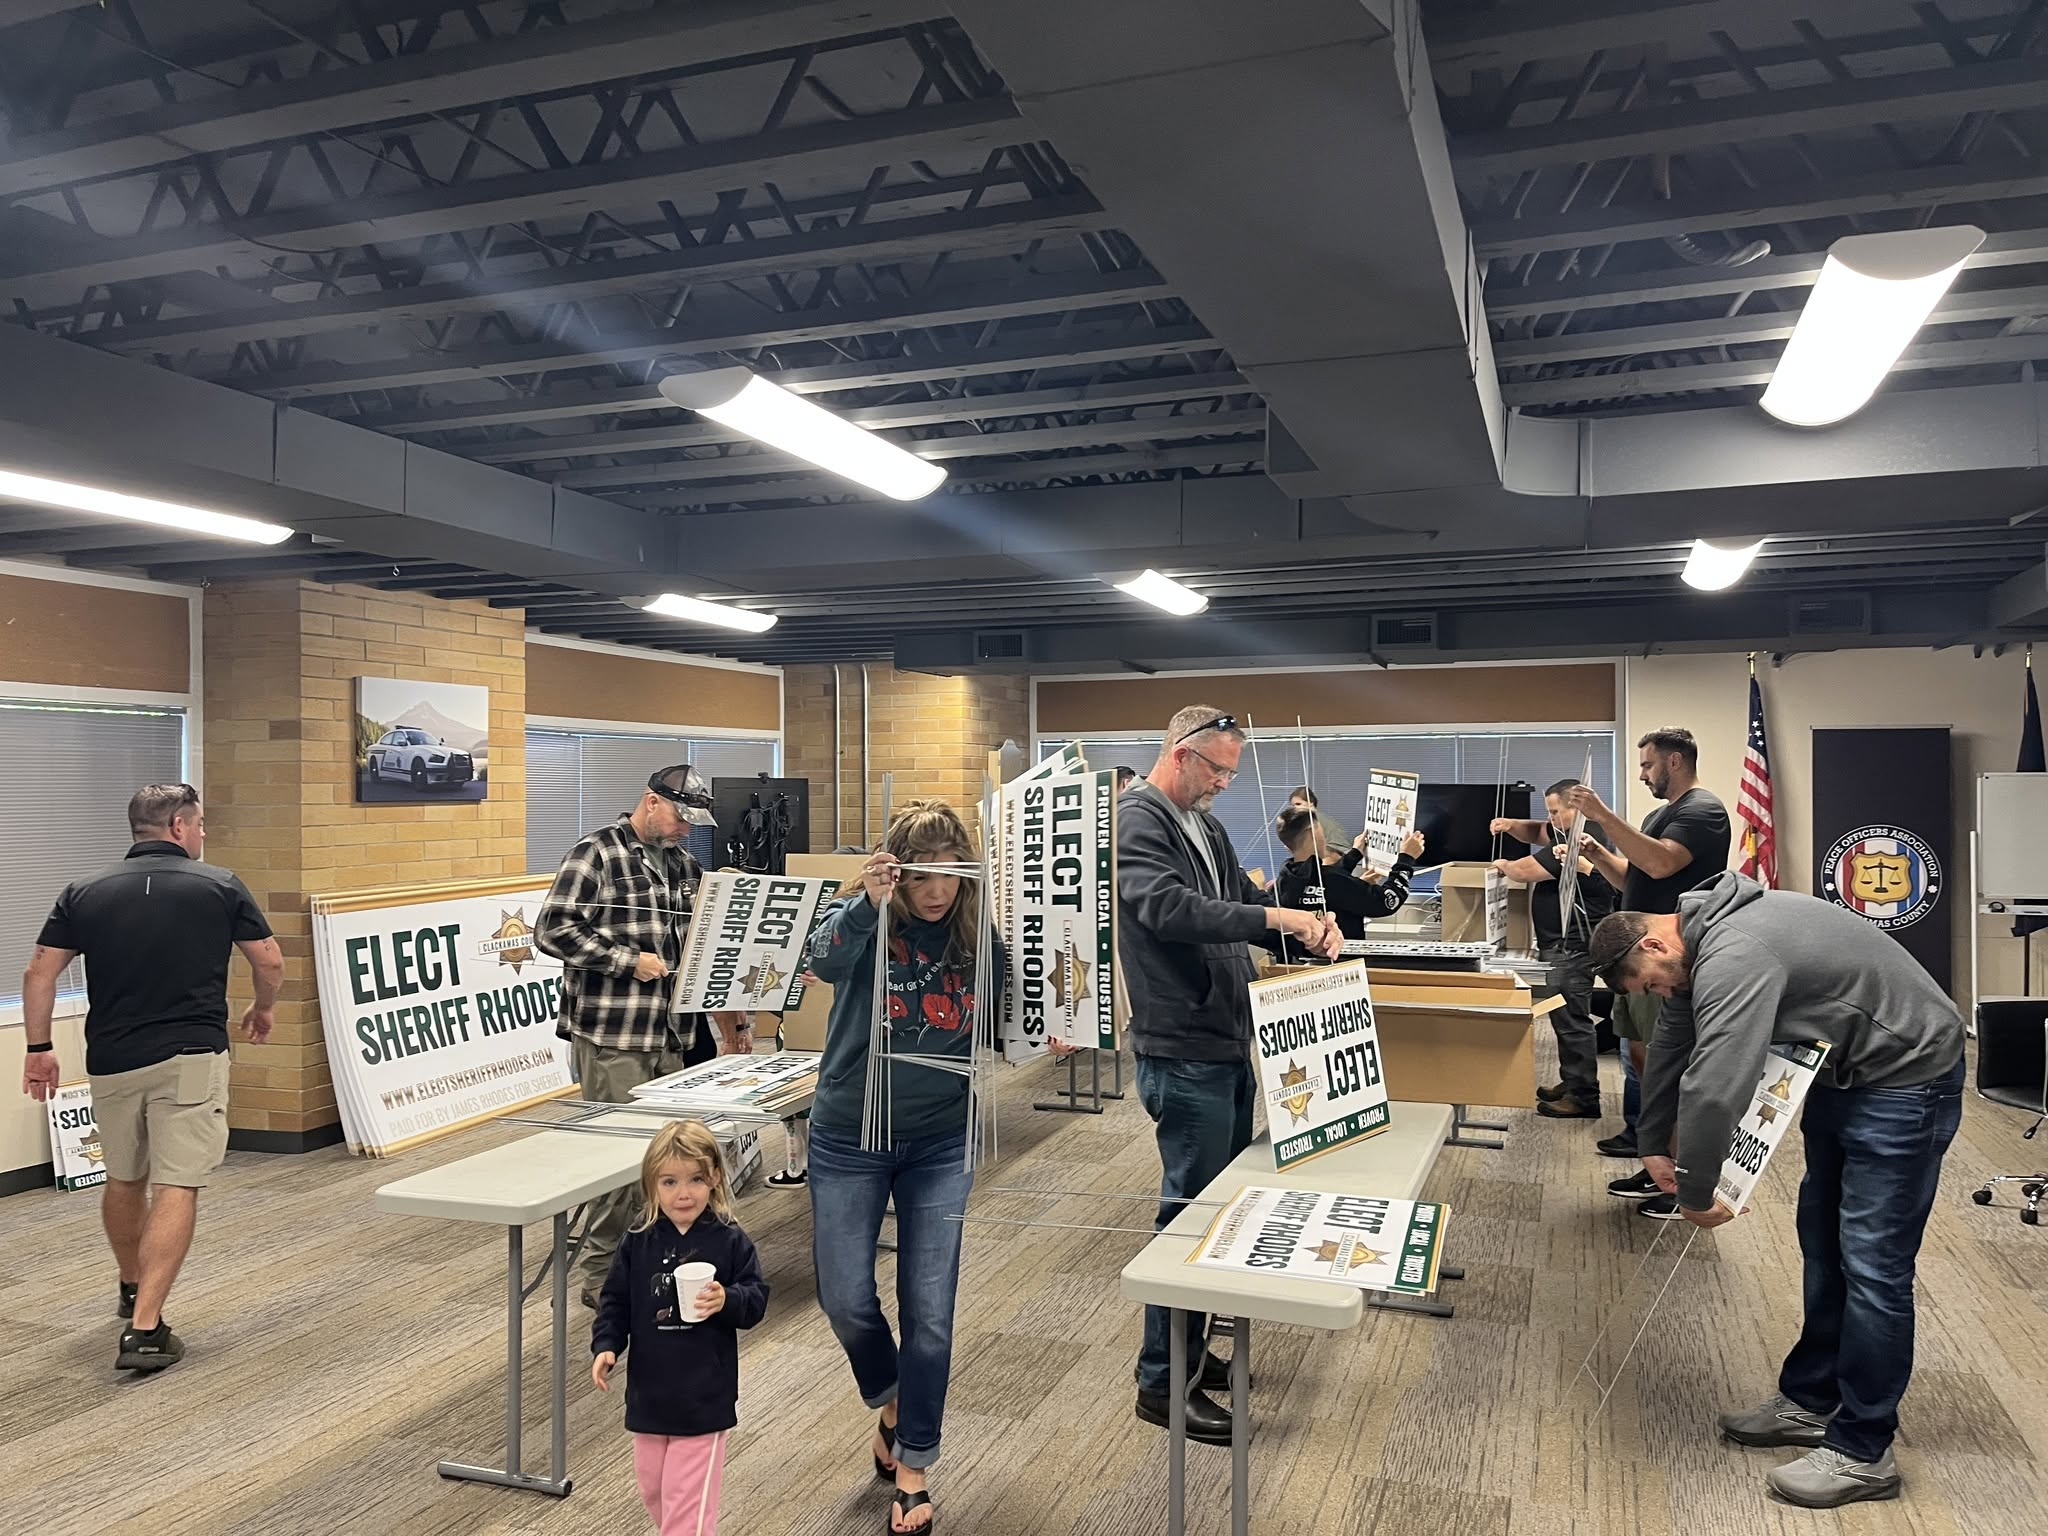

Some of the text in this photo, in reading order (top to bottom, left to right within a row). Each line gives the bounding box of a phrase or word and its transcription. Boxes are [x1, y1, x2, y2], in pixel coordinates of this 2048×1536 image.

[1367, 795, 1391, 826] ELECT
[1051, 784, 1083, 913] ELECT
[1824, 828, 1939, 878] PEACE OFFICERS ASSOCIATION
[753, 880, 807, 950] ELECT
[1003, 799, 1015, 1024] WWW.ELECTSHERIFFRHODES.COM
[1022, 785, 1044, 1038] SHERIFF RHODES
[1097, 785, 1113, 1035] PROVEN LOCAL TRUSTED
[1892, 900, 1931, 927] COUNTY
[345, 923, 461, 1006] ELECT
[482, 936, 534, 952] CLACKAMAS COU
[701, 877, 761, 1009] SHERIFF RHODES
[355, 995, 470, 1066] SHERIFF
[1065, 990, 1073, 1029] COUNTY
[1258, 997, 1372, 1059] SHERIFF RHODES
[380, 1046, 555, 1111] WWW.ELECTSHERIFFRHODES.COM
[1273, 1077, 1320, 1101] CLACKAMAS COUNTY
[1324, 1040, 1381, 1101] ELECT
[59, 1106, 96, 1130] DES
[390, 1071, 563, 1138] PAID FOR BY JAMES RHODES FOR SHERIFF
[1280, 1106, 1385, 1161] PROVEN LOCAL TRUSTED
[75, 1172, 107, 1188] RUSTED
[1729, 1126, 1770, 1176] RHODES
[1244, 1191, 1322, 1269] SHERIFF RHODES
[1323, 1196, 1390, 1235] ELECT
